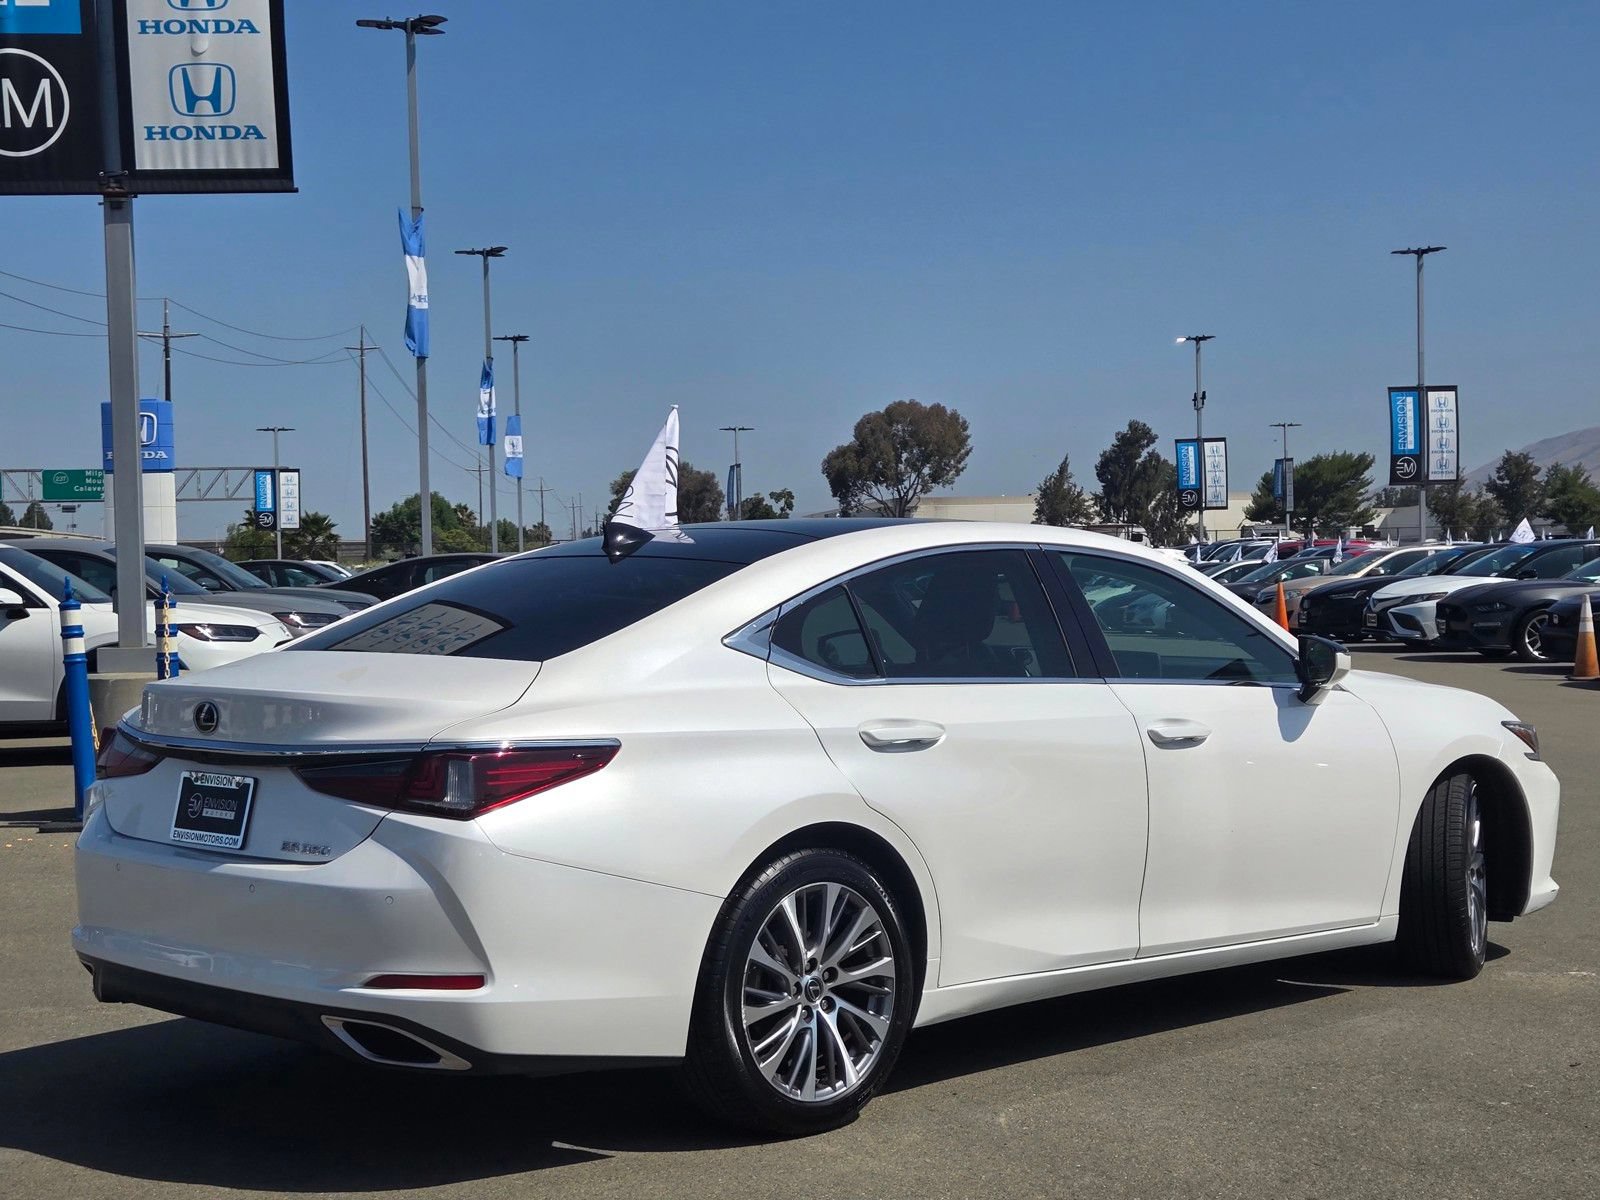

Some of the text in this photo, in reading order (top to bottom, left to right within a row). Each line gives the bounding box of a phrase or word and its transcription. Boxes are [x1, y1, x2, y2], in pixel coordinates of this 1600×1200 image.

[137, 19, 260, 34] HONDA
[144, 125, 267, 141] HONDA
[1396, 395, 1408, 450] ENVISION
[85, 470, 103, 478] Milp
[201, 773, 234, 787] ENVISION
[203, 797, 238, 811] ENVISION
[172, 829, 240, 847] ENVISIONMOTORS.COM
